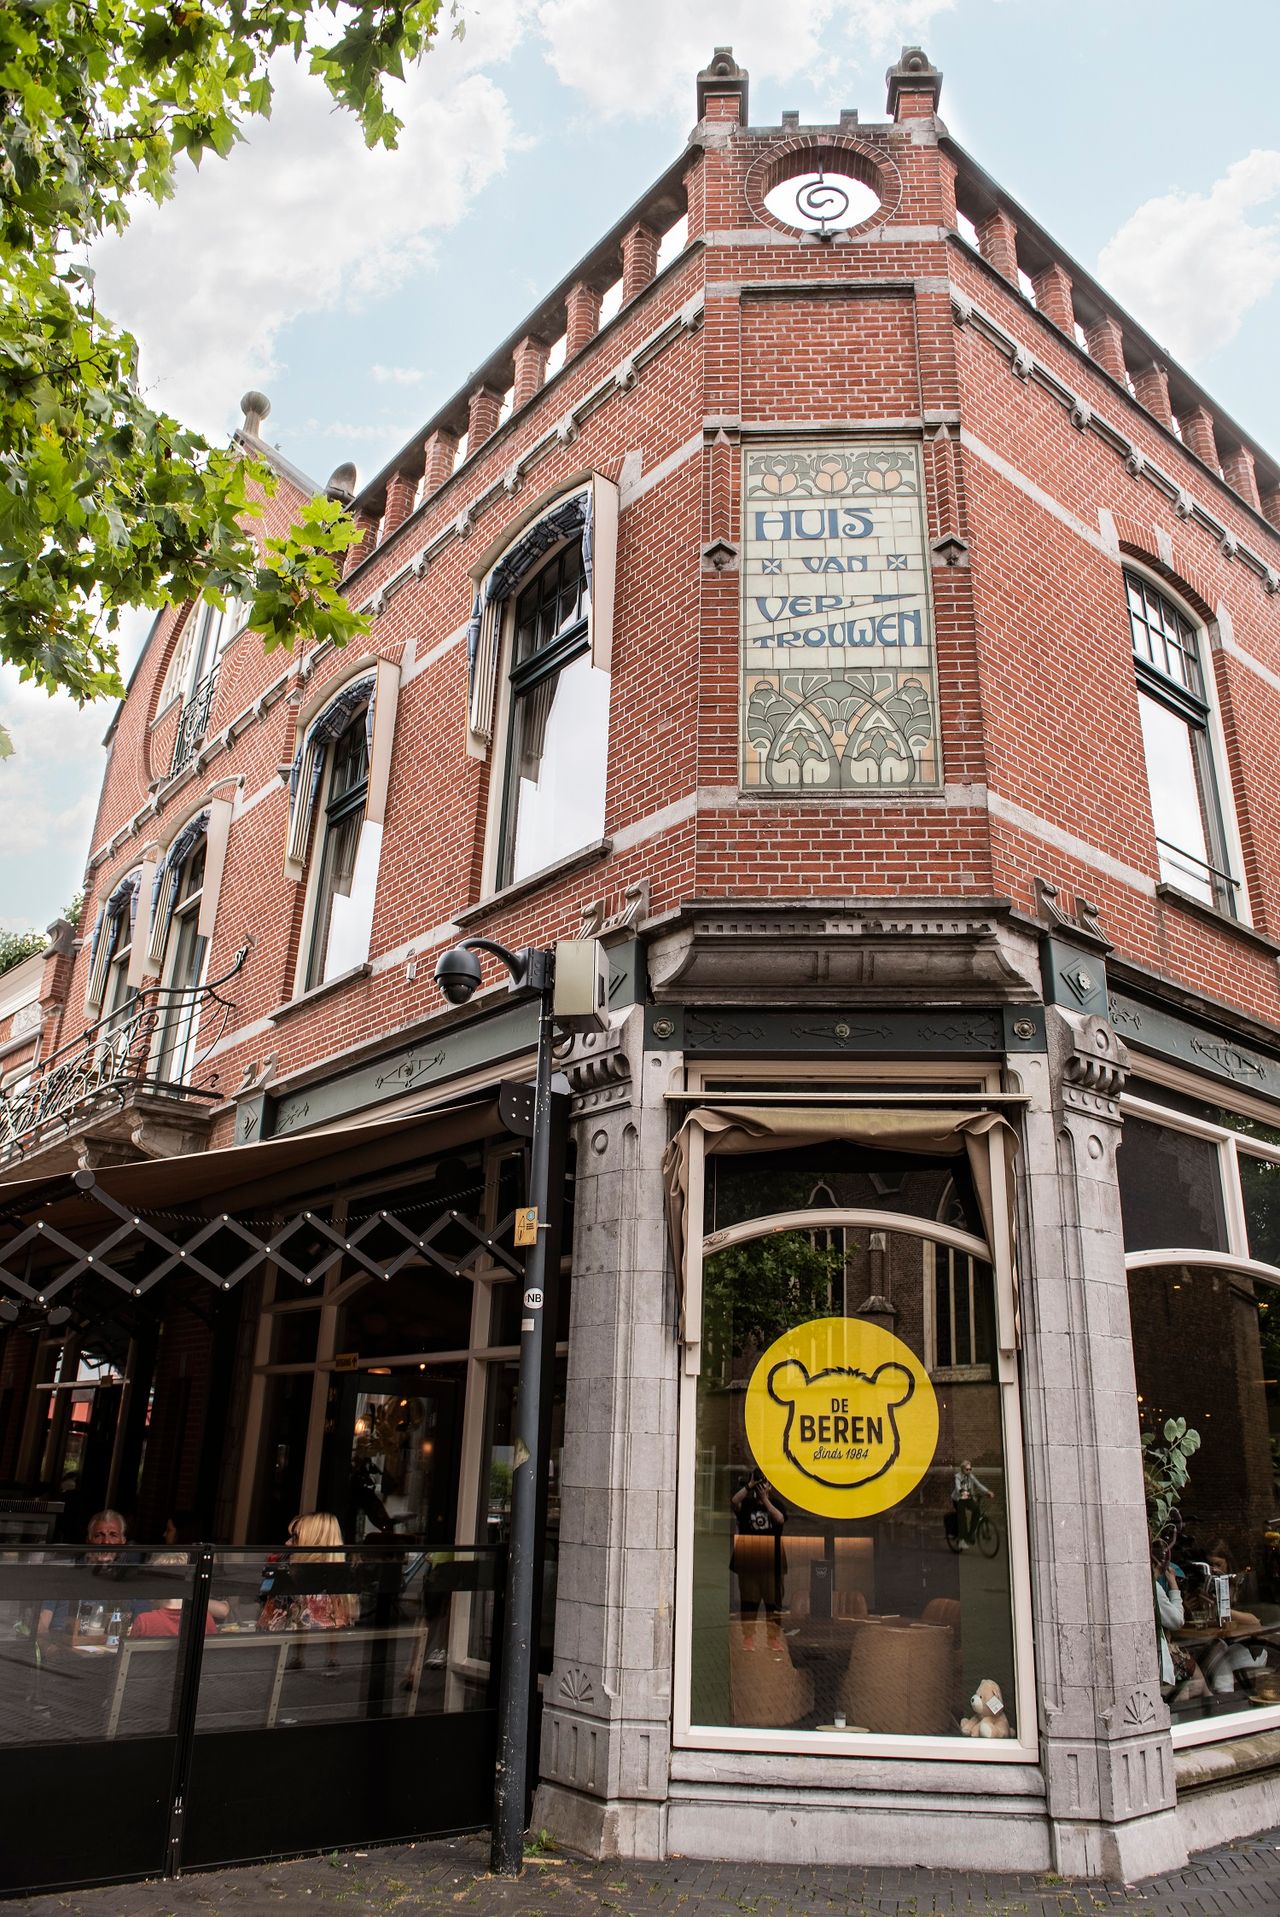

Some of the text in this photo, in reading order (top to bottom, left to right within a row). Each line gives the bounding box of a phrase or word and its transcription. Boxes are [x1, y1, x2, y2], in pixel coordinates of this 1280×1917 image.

[755, 507, 874, 541] HUIS
[802, 555, 868, 573] VAN
[753, 609, 923, 649] TROUWEN
[527, 1293, 542, 1303] NB
[831, 1398, 849, 1413] DE
[800, 1415, 883, 1445] BEREN
[813, 1446, 869, 1461] Sinds 1984
